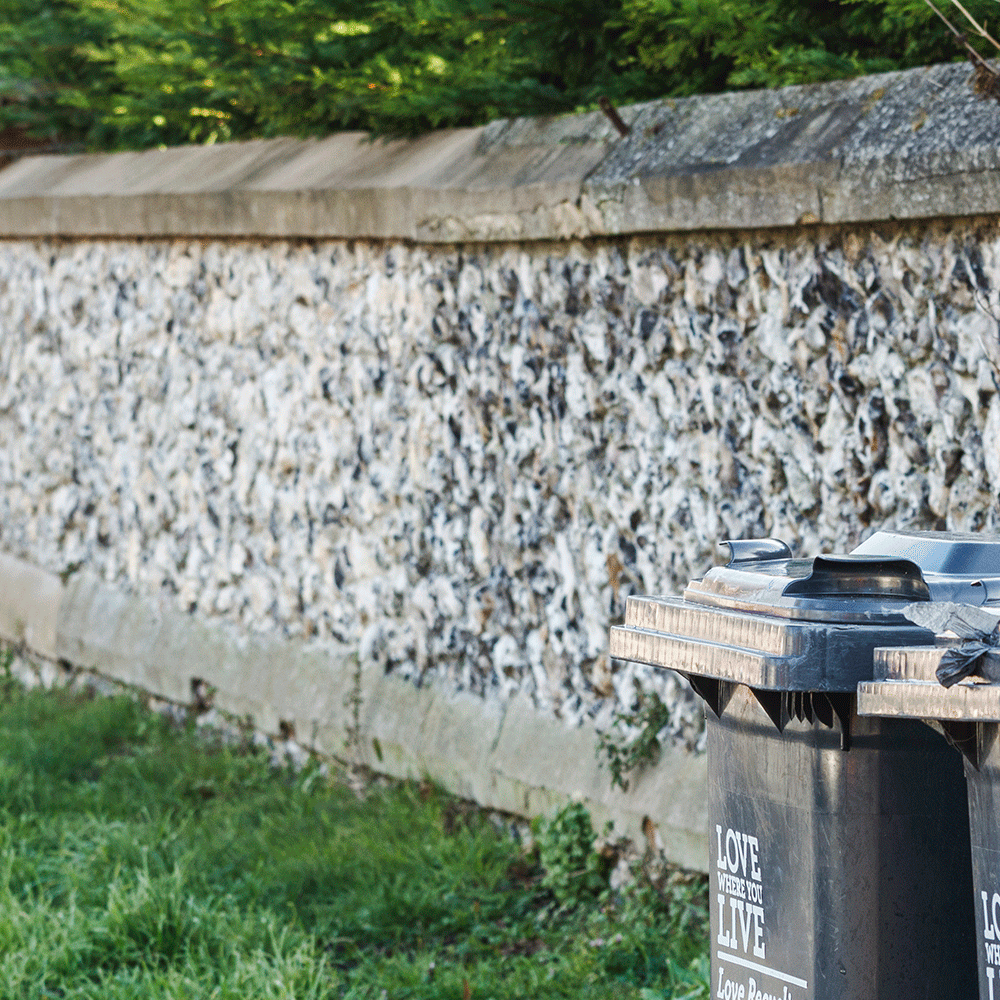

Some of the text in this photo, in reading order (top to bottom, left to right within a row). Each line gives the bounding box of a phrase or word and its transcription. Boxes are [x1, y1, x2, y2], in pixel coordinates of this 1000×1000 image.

[716, 824, 762, 882] LOVE
[718, 872, 763, 906] WHERE YOU
[718, 894, 766, 960] LIVE
